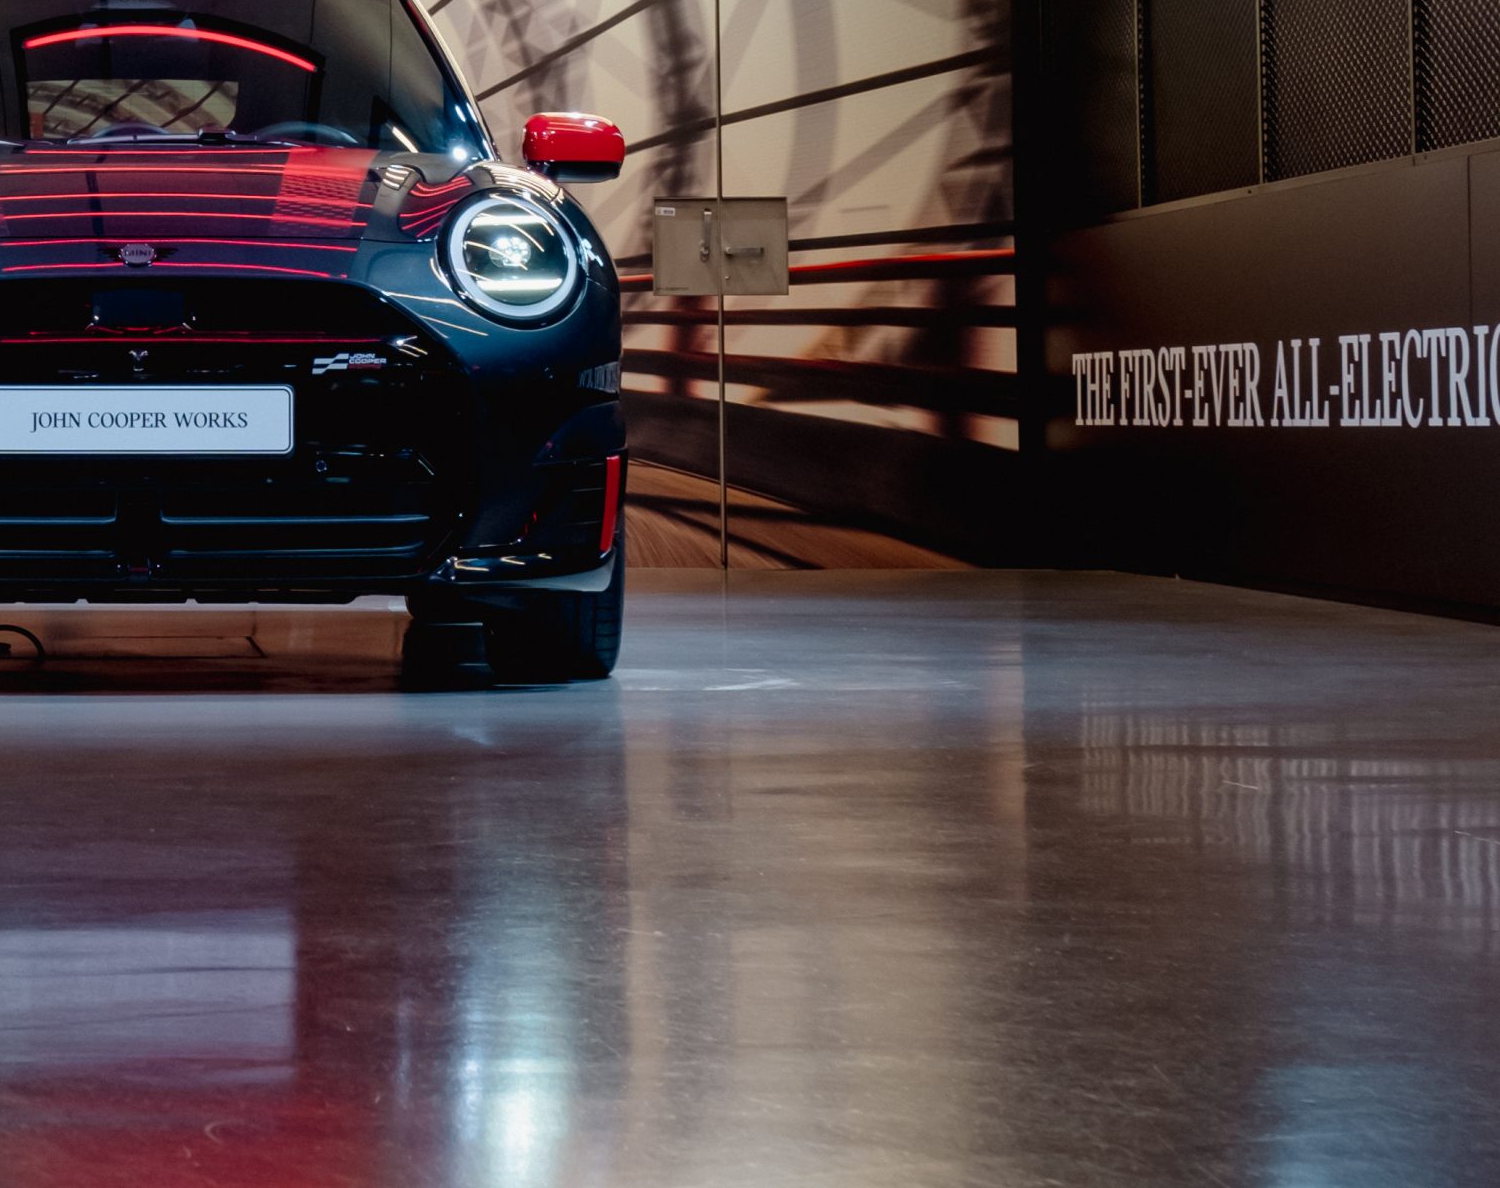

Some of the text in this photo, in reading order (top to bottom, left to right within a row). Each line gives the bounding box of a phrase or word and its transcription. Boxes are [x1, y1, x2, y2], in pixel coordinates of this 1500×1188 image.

[1072, 351, 1115, 427] THE
[1118, 342, 1265, 428] FIRST-EVER
[29, 411, 249, 434] JOHN COOPER WORKS
